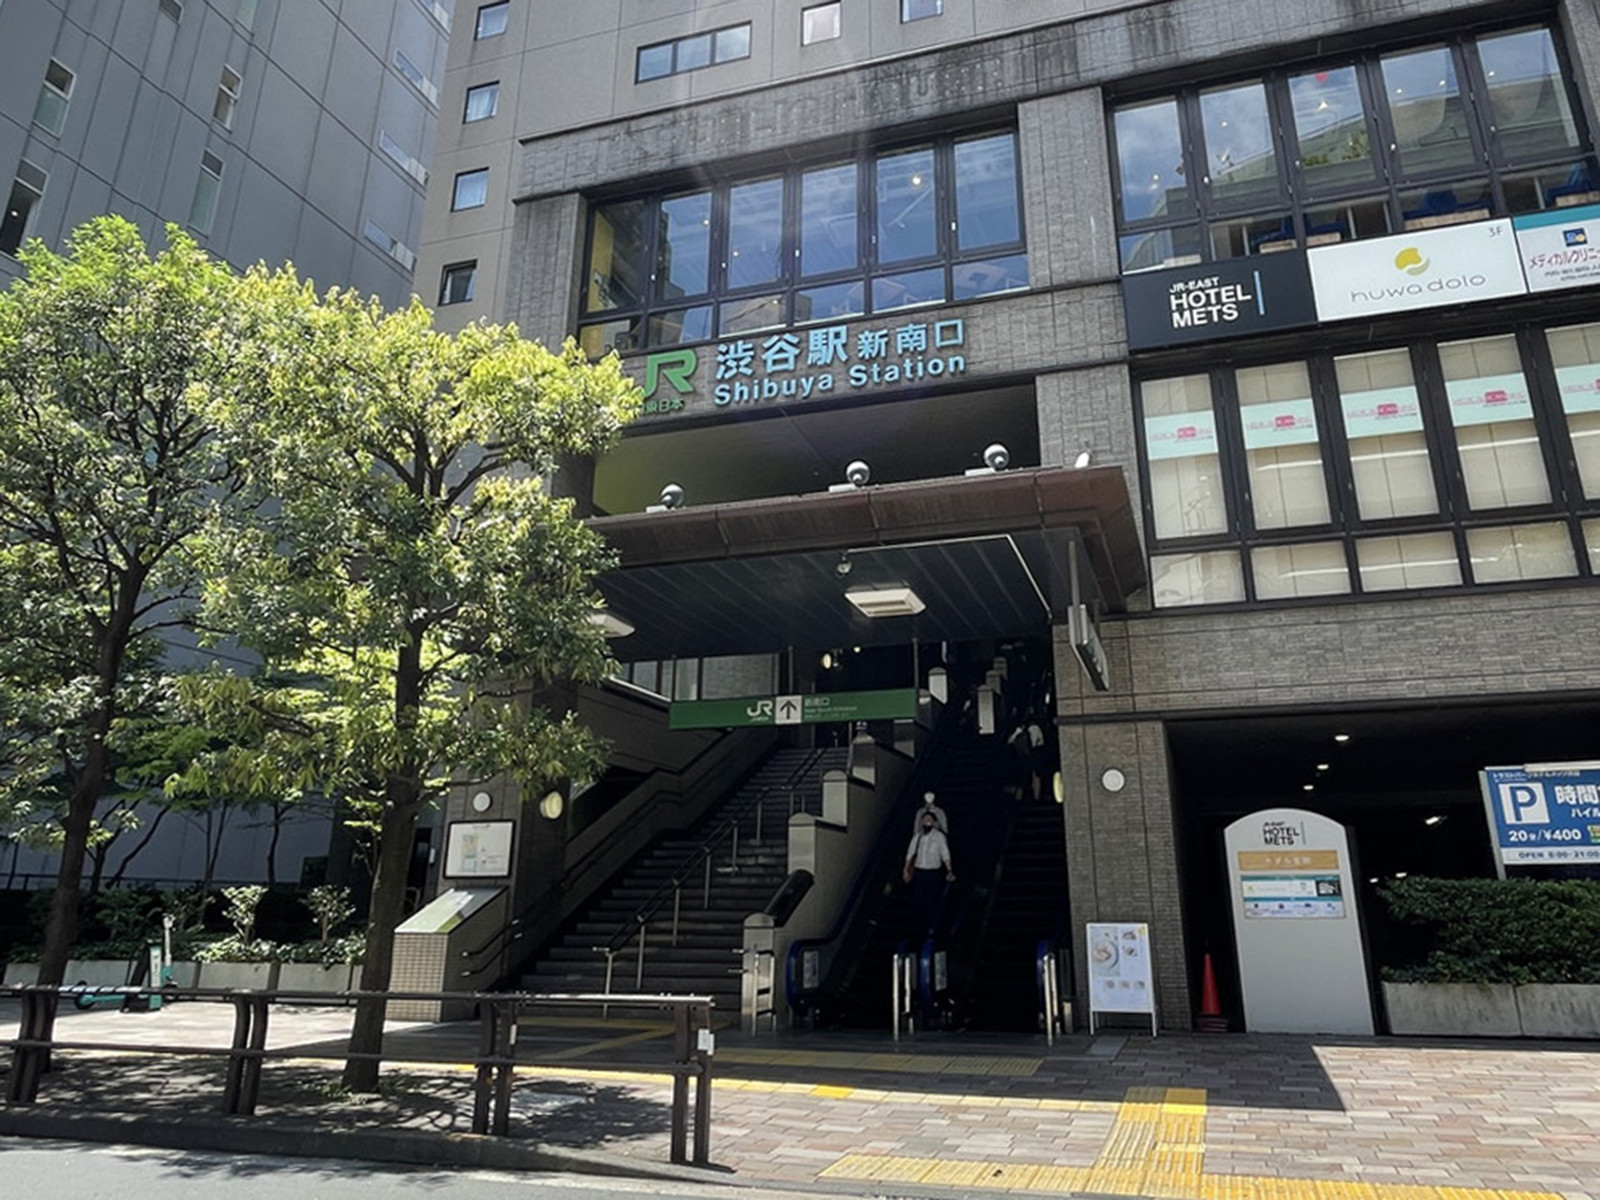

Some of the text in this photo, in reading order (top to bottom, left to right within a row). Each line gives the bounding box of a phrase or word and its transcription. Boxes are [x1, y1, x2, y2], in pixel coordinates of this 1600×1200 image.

[1169, 276, 1220, 293] JR-EAST
[1169, 284, 1252, 311] HOTEL
[1171, 303, 1240, 329] METS
[713, 353, 966, 407] Shibuya Station
[747, 700, 772, 716] JR
[1553, 784, 1600, 805] 時間
[1263, 826, 1300, 837] HOTEL
[1264, 836, 1295, 846] METS
